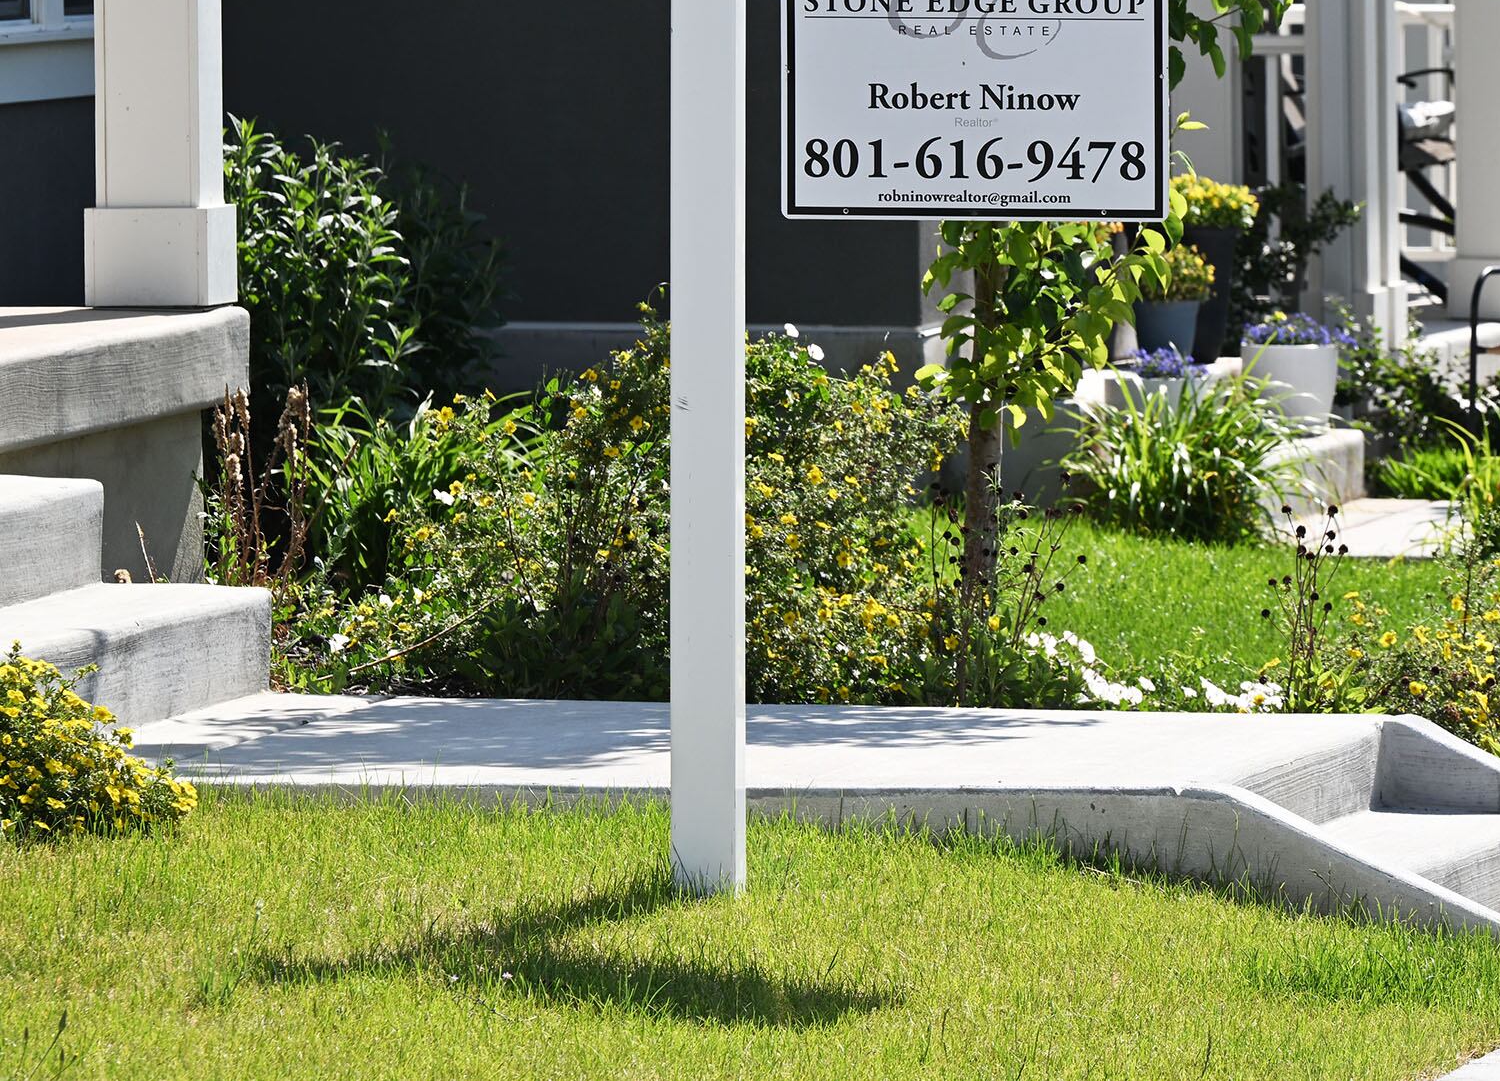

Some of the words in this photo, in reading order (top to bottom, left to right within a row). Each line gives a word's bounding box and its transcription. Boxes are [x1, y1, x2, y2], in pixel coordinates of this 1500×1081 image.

[899, 25, 951, 36] REAL
[970, 25, 1050, 36] ESTATE
[868, 82, 971, 110] Robert
[979, 83, 1081, 111] Ninow
[804, 136, 1146, 184] 801-616-9478
[878, 189, 1071, 207] robninowrealtor@gmail.com
